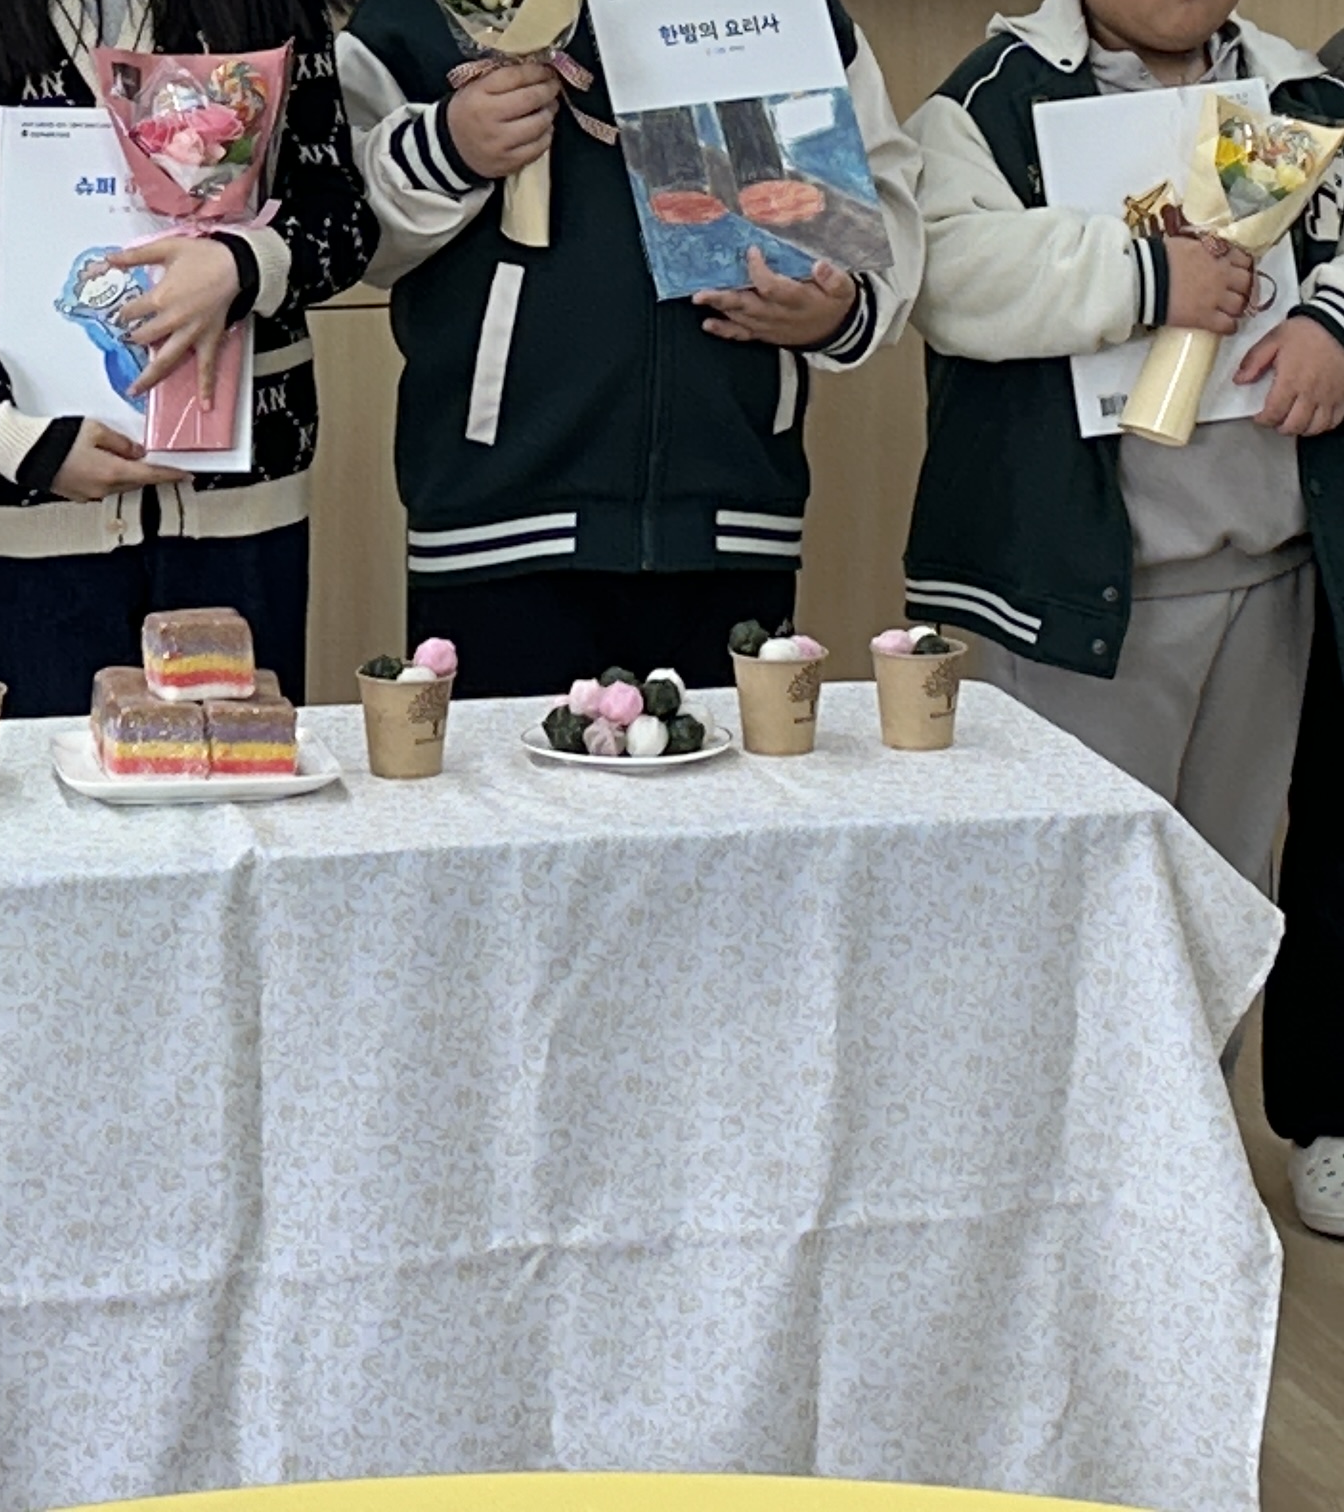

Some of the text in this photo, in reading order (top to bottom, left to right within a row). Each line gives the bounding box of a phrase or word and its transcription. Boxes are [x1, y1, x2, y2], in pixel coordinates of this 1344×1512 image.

[658, 13, 780, 46] 한밤의 요리사
[75, 176, 116, 196] 슈퍼
